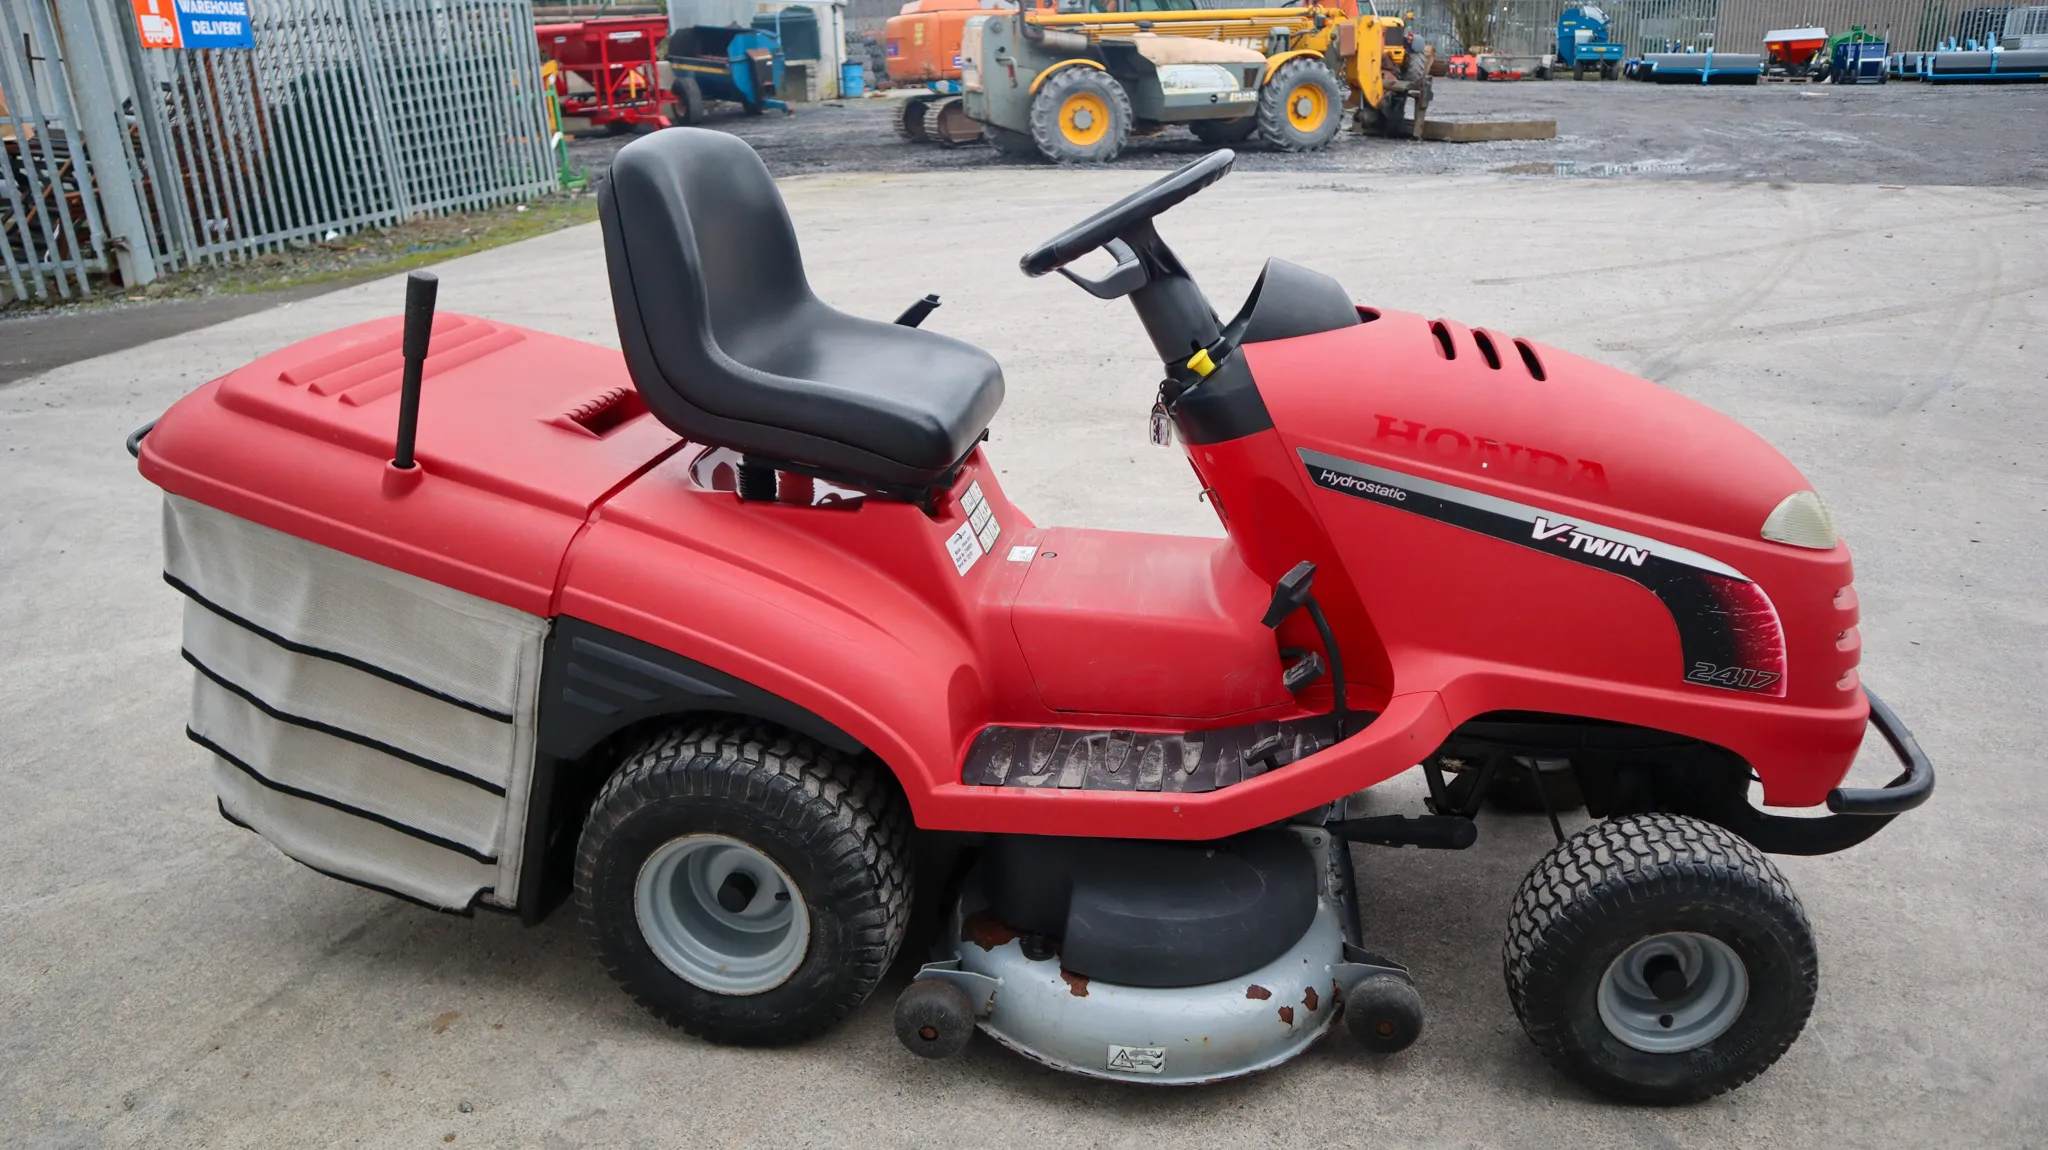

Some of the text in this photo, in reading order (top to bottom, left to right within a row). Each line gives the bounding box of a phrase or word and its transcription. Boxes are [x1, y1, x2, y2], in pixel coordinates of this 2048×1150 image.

[177, 0, 247, 15] WAREHOUSE
[191, 20, 241, 35] DELIVERY
[1370, 413, 1612, 494] HONDA
[1320, 469, 1407, 501] Hydrostatic
[1531, 516, 1651, 567] V-TWIN
[1688, 662, 1780, 689] 2417
